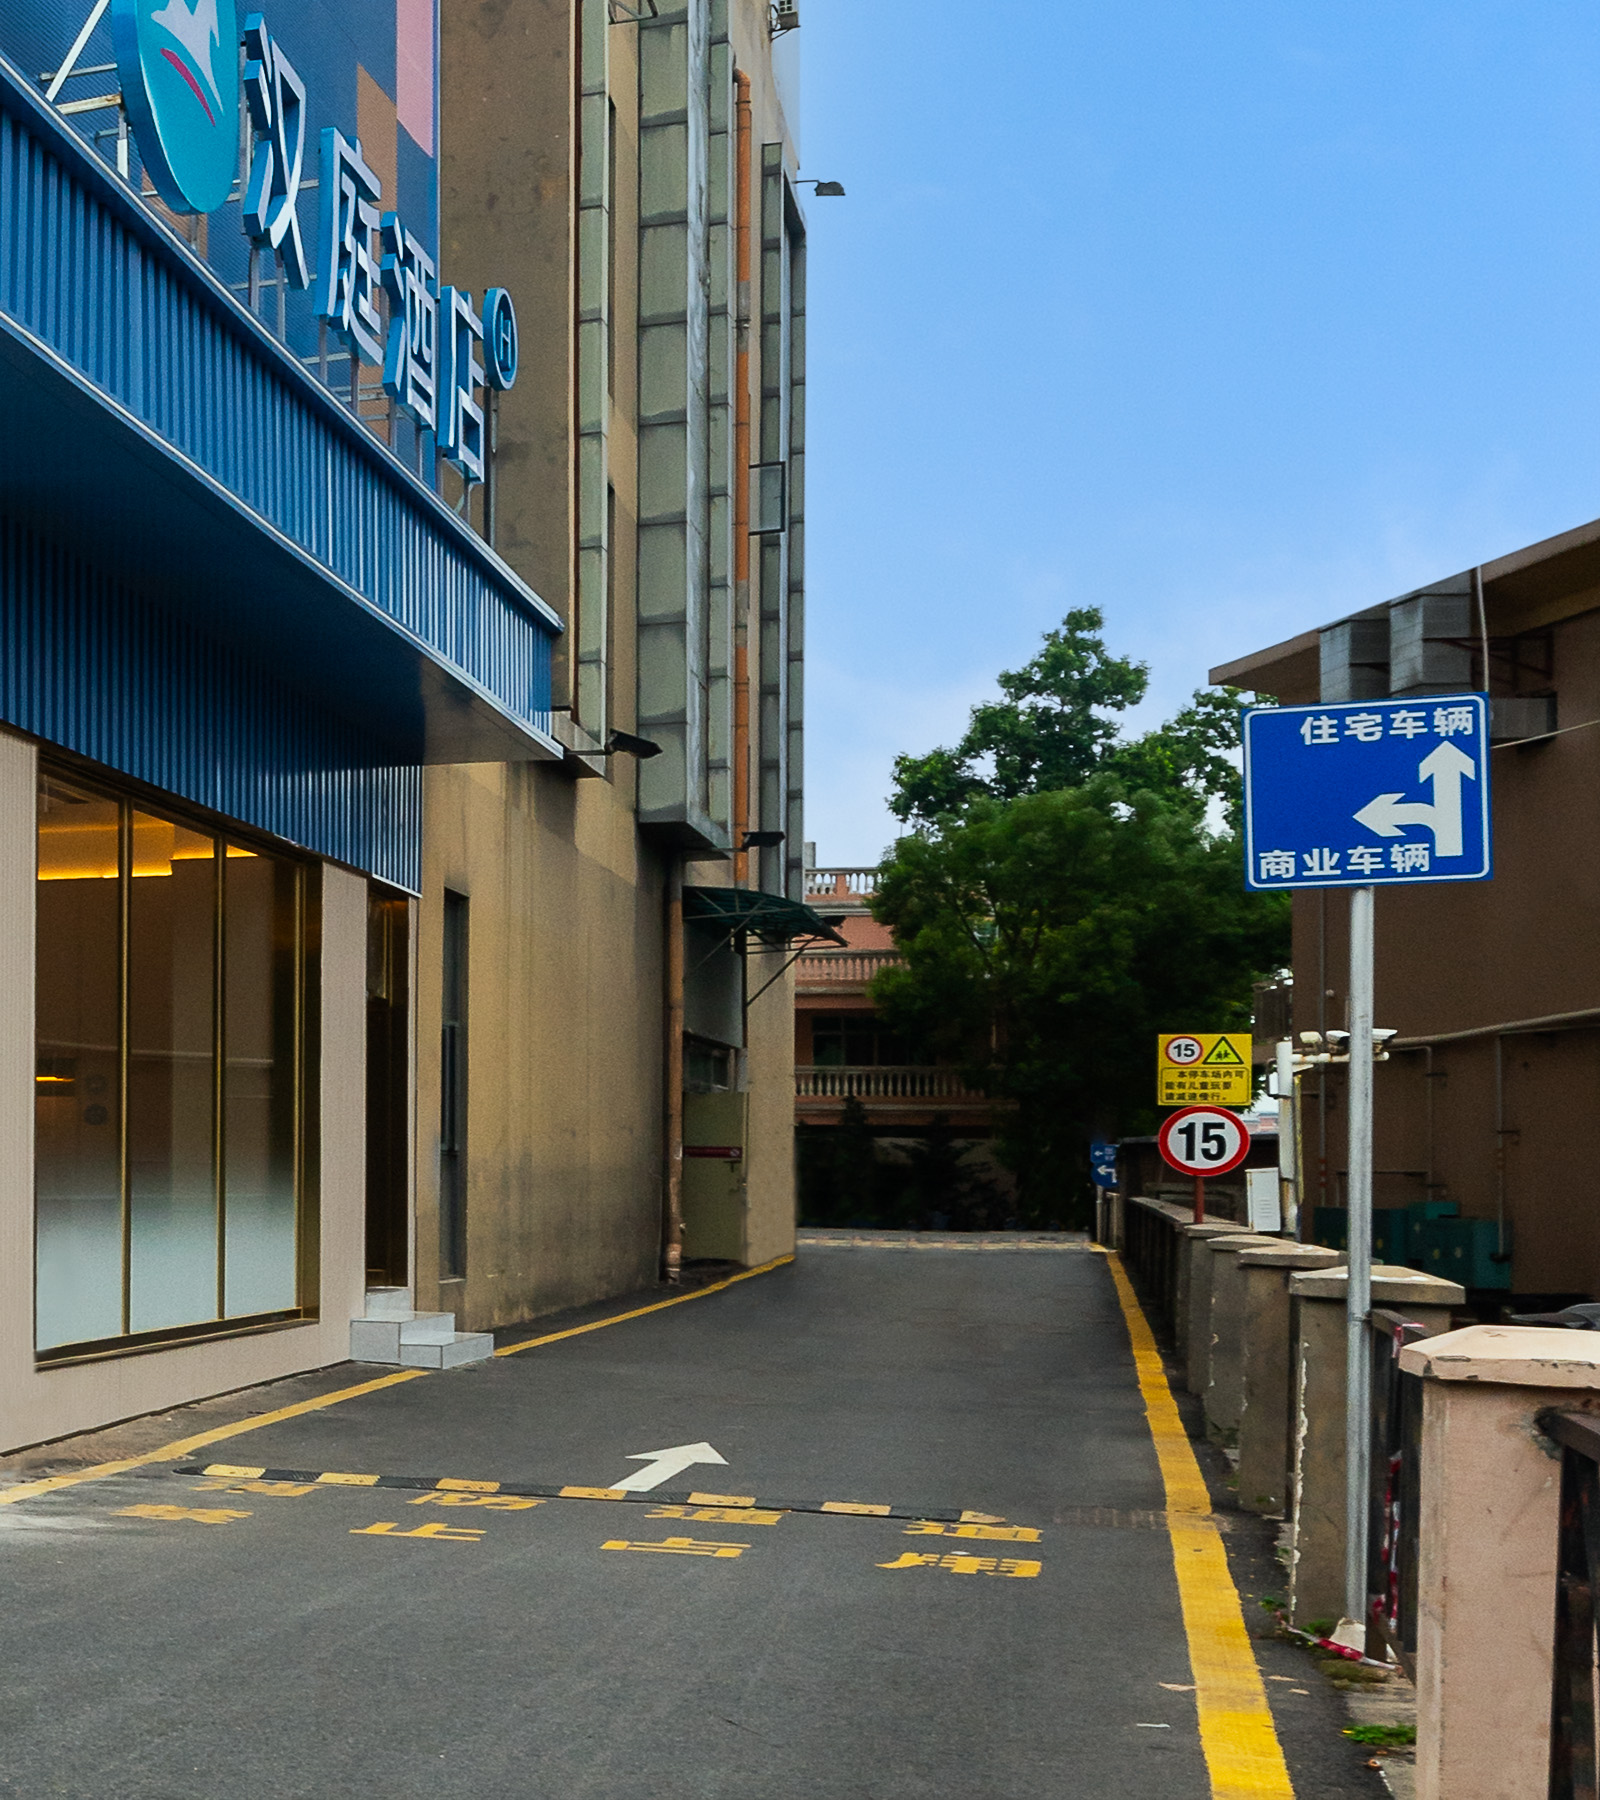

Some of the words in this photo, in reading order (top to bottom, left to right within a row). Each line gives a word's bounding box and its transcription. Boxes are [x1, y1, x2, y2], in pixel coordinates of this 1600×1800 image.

[243, 12, 485, 484] 汉庭酒店
[1299, 705, 1474, 746] 住宅车辆
[1258, 842, 1430, 880] 商业车辆
[1173, 1043, 1196, 1058] 15
[1176, 1121, 1227, 1162] 15
[110, 1503, 1042, 1578] 禁止占用
